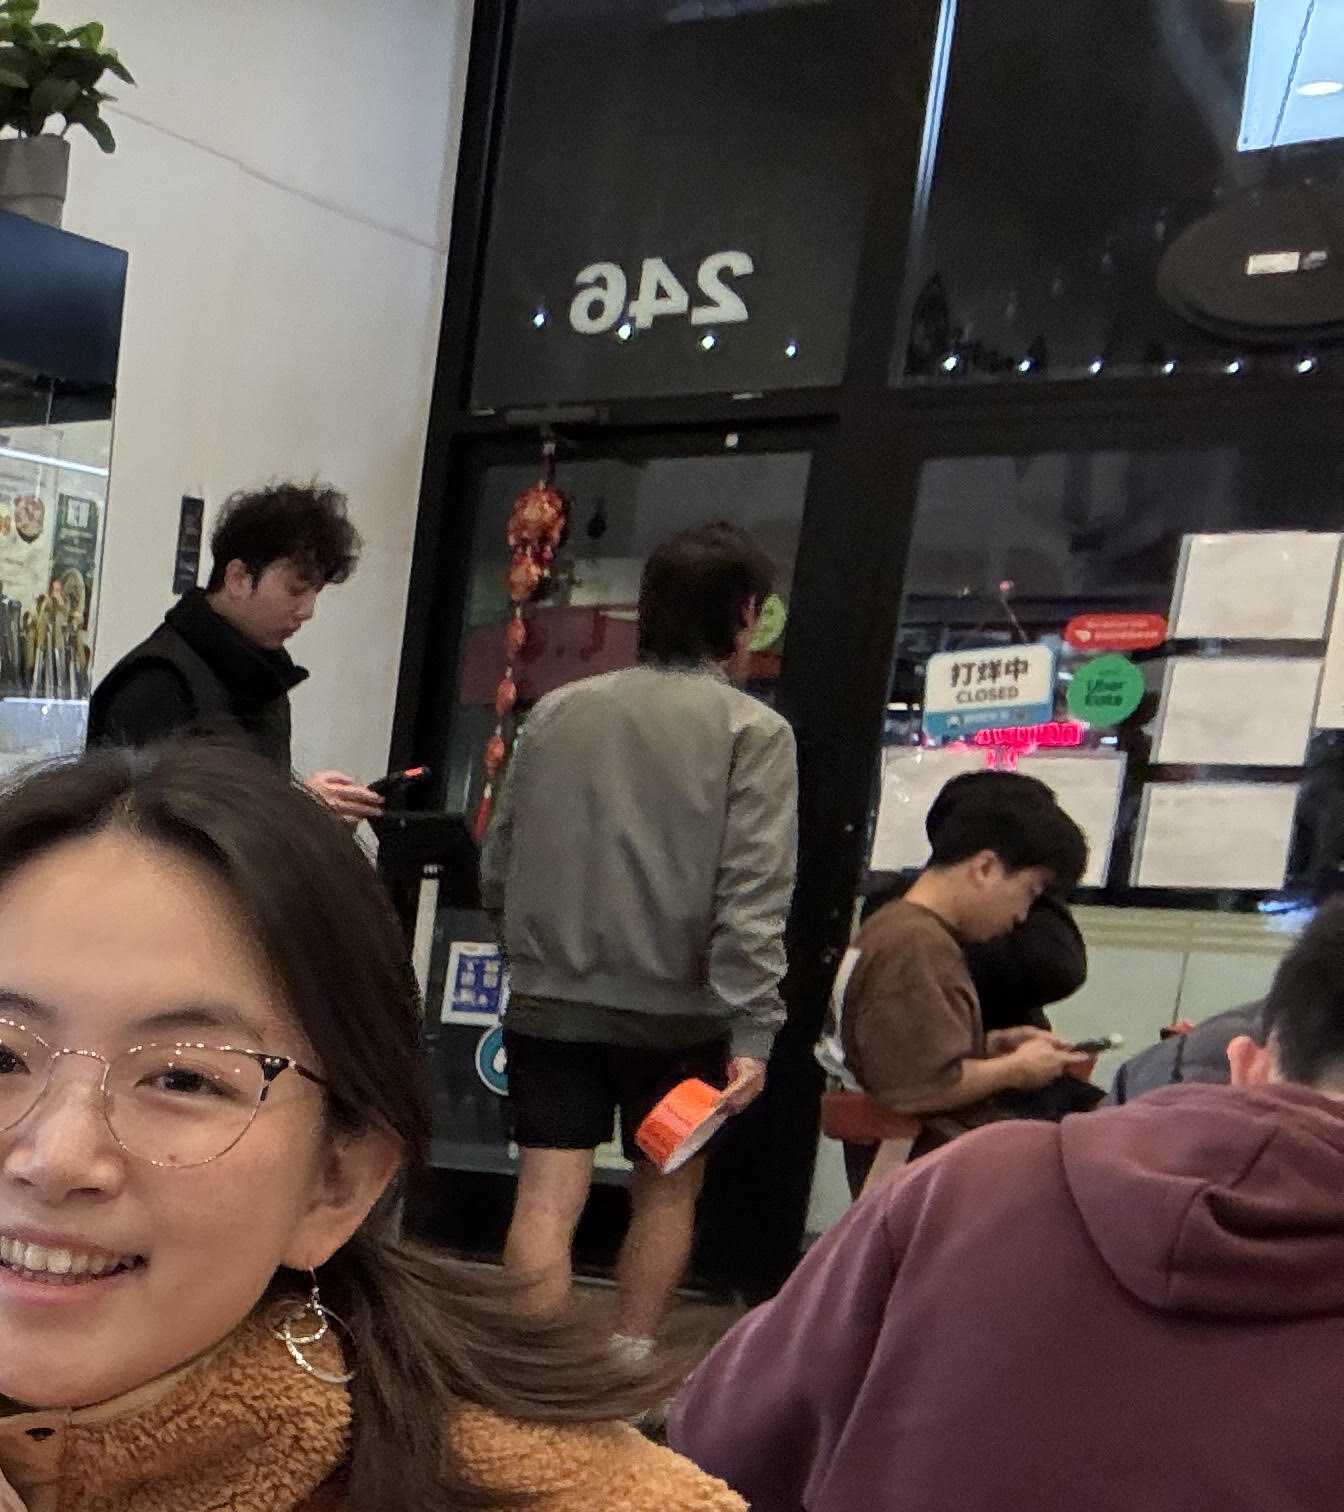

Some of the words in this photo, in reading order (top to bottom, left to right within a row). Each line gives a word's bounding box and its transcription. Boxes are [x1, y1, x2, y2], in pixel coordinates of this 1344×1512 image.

[950, 655, 1030, 689] 打烊中
[955, 685, 1020, 705] CLOSED
